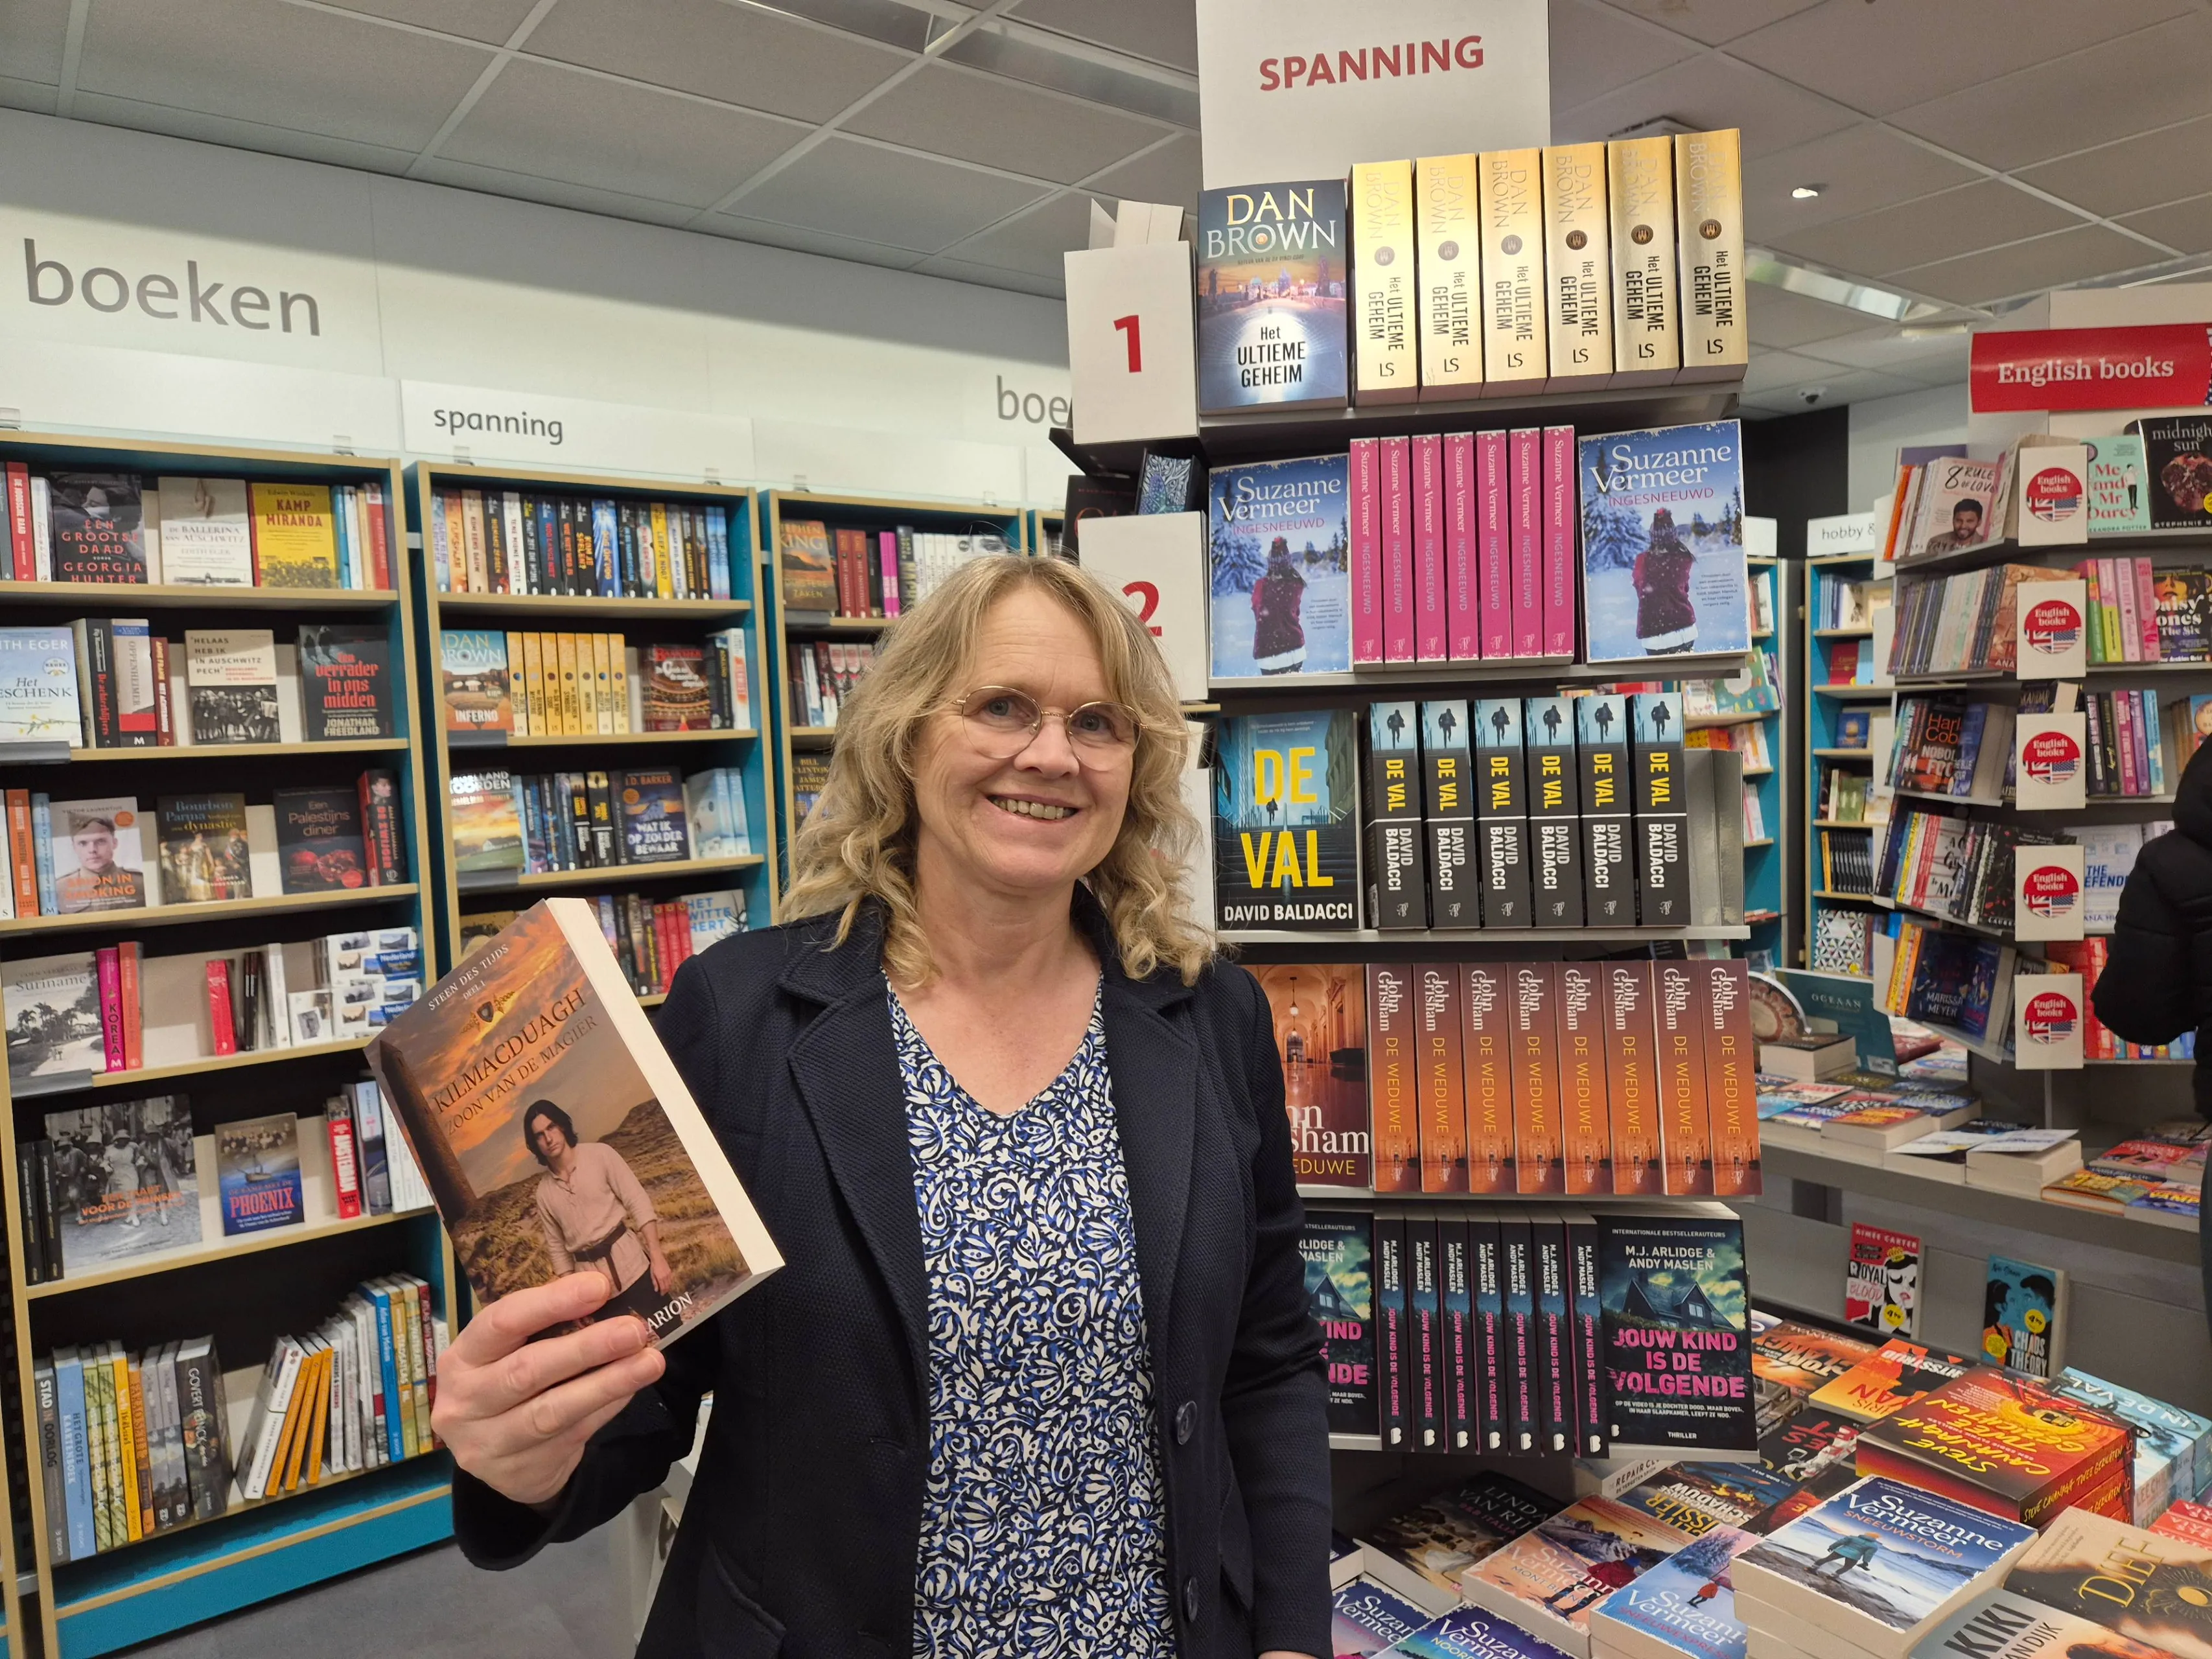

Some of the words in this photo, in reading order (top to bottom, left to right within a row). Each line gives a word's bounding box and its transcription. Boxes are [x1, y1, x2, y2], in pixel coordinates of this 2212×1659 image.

[1259, 35, 1484, 91] SPANNING
[1492, 160, 1510, 227] BROWN
[1510, 169, 1528, 215] DAN
[1226, 188, 1314, 226] DAN
[1207, 220, 1337, 259] BROWN
[1517, 266, 1529, 283] Het
[23, 237, 321, 337] boeken
[1496, 281, 1513, 330] GEHEIM
[1515, 286, 1532, 341] ULTIEME
[1113, 314, 1143, 373] 1
[1260, 326, 1281, 340] Het
[1237, 341, 1306, 366] ULTIEME
[1507, 353, 1523, 368] LS
[1240, 364, 1303, 388] GEHEIM
[1997, 358, 2091, 388] English
[2099, 356, 2174, 380] books
[995, 375, 1071, 426] boe
[433, 406, 564, 446] spanning
[2152, 419, 2212, 440] midnigh
[2173, 439, 2201, 452] sun
[1555, 440, 1564, 482] Suzanne
[1612, 444, 1732, 473] Suzanne
[1589, 465, 1708, 493] Vermeer
[1944, 465, 1964, 490] 8
[2095, 463, 2120, 476] Me
[1237, 476, 1341, 502] Suzanne
[2036, 475, 2071, 486] English
[2040, 483, 2067, 493] books
[2093, 479, 2125, 491] and
[276, 498, 311, 511] KAMP
[1555, 483, 1564, 527] Vermeer
[1609, 487, 1714, 507] INGESNEEUWD
[2099, 493, 2121, 505] Mr
[1218, 496, 1320, 521] Vermeer
[181, 526, 240, 535] BALLERINA
[266, 513, 323, 527] MIRANDA
[1233, 518, 1325, 535] INGESNEEUWD
[62, 531, 139, 542] GROOTSE
[1822, 524, 1863, 540] hobby
[79, 544, 124, 554] DAAD
[64, 562, 143, 572] GEORGIA
[71, 575, 137, 583] HUNTER
[1122, 581, 1163, 637] 2
[2034, 607, 2069, 619] English
[2038, 616, 2066, 626] books
[29, 639, 69, 651] EGER
[444, 633, 490, 649] DAN
[209, 656, 262, 665] AUSCHWITZ
[315, 660, 379, 677] verrader
[16, 677, 38, 688] Het
[328, 677, 342, 692] in
[343, 679, 370, 693] ons
[323, 693, 377, 708] midden
[327, 717, 377, 727] JONATHAN
[455, 710, 499, 723] INFERNO
[323, 726, 380, 737] FREEDLAND
[2032, 738, 2069, 750] English
[2036, 747, 2065, 757] books
[640, 774, 672, 785] BARKER
[1254, 747, 1318, 806] DE
[1386, 759, 1404, 780] DE
[175, 800, 233, 811] Bourbon
[1388, 782, 1406, 811] VAL
[166, 811, 206, 822] Parma
[288, 809, 351, 825] Palestijns
[660, 820, 671, 832] IK
[303, 824, 340, 837] diner
[1399, 828, 1414, 866] DAVID
[1240, 830, 1334, 888] VAL
[1386, 828, 1401, 891] BALDACCI
[2032, 872, 2068, 885] English
[2086, 864, 2108, 876] THE
[2036, 881, 2064, 891] books
[1224, 905, 1270, 922] DAVID
[1274, 903, 1353, 921] BALDACCI
[690, 919, 726, 932] HERT
[15, 974, 87, 993] Suriname
[428, 982, 459, 1011] STEEN
[459, 968, 480, 986] DES
[479, 944, 509, 969] TIJDS
[463, 983, 479, 1000] DEEL
[1377, 971, 1393, 1032] Grisham
[1388, 980, 1403, 1013] John
[1927, 992, 1963, 1004] MARISSA
[2032, 999, 2066, 1010] English
[2036, 1007, 2063, 1017] books
[432, 987, 587, 1115] KILMACDUAGH
[1386, 1038, 1399, 1056] DE
[447, 1101, 484, 1136] ZOON
[486, 1075, 517, 1104] VAN
[517, 1062, 539, 1081] DE
[541, 1014, 598, 1063] MAGIËR
[1387, 1063, 1401, 1133] WEDUWE
[229, 1187, 295, 1218] PHOENIX
[1337, 1240, 1345, 1251] &
[1855, 1228, 1881, 1240] AIMEE
[1884, 1235, 1917, 1249] CARTER
[1625, 1246, 1649, 1257] M.J.
[1652, 1246, 1703, 1258] ARLIDGE
[1706, 1248, 1715, 1259] &
[1628, 1259, 1662, 1270] ANDY
[1664, 1260, 1714, 1271] MASLEN
[1849, 1261, 1887, 1284] ROYAL
[1849, 1280, 1883, 1301] BLOOD
[646, 1291, 693, 1332] ARION
[1388, 1307, 1397, 1331] JOUW
[1613, 1328, 1677, 1349] JOUW
[1682, 1331, 1737, 1352] KIND
[2014, 1330, 2045, 1357] CHAOS
[1390, 1362, 1398, 1373] DE
[1646, 1351, 1667, 1370] IS
[1671, 1352, 1702, 1372] DE
[1780, 1348, 1830, 1377] TOM
[2010, 1350, 2047, 1378] THEORY
[40, 1379, 52, 1408] STAD
[1612, 1371, 1746, 1398] VOLGENDE
[2069, 1376, 2113, 1401] VAL
[1391, 1376, 1399, 1417] VOLGENDE
[2117, 1396, 2156, 1414] DE
[1667, 1431, 1697, 1439] THRILLER
[1926, 1398, 2086, 1452] GEZICHTEN
[1946, 1417, 2037, 1453] TWEE
[1892, 1417, 2051, 1476] CAVANAGH
[1903, 1438, 1998, 1473] STEVE
[1615, 1464, 1644, 1486] REPAIR
[1458, 1489, 1500, 1515] VAN
[1484, 1486, 1549, 1523] LINDA
[1670, 1482, 1753, 1522] SCHADUW
[2023, 1502, 2042, 1523] STEVE
[2042, 1479, 2075, 1507] CAVANAGH
[1847, 1493, 1968, 1548] Vermeer
[1872, 1494, 2003, 1551] Suzanne
[1843, 1510, 1963, 1559] SNEEUWSTORM
[1511, 1565, 1544, 1586] MONT
[2078, 1537, 2165, 1607] DIEF
[1627, 1589, 1732, 1646] Vermeer
[1942, 1603, 2037, 1659] KIKI
[2028, 1621, 2063, 1649] DIJK
